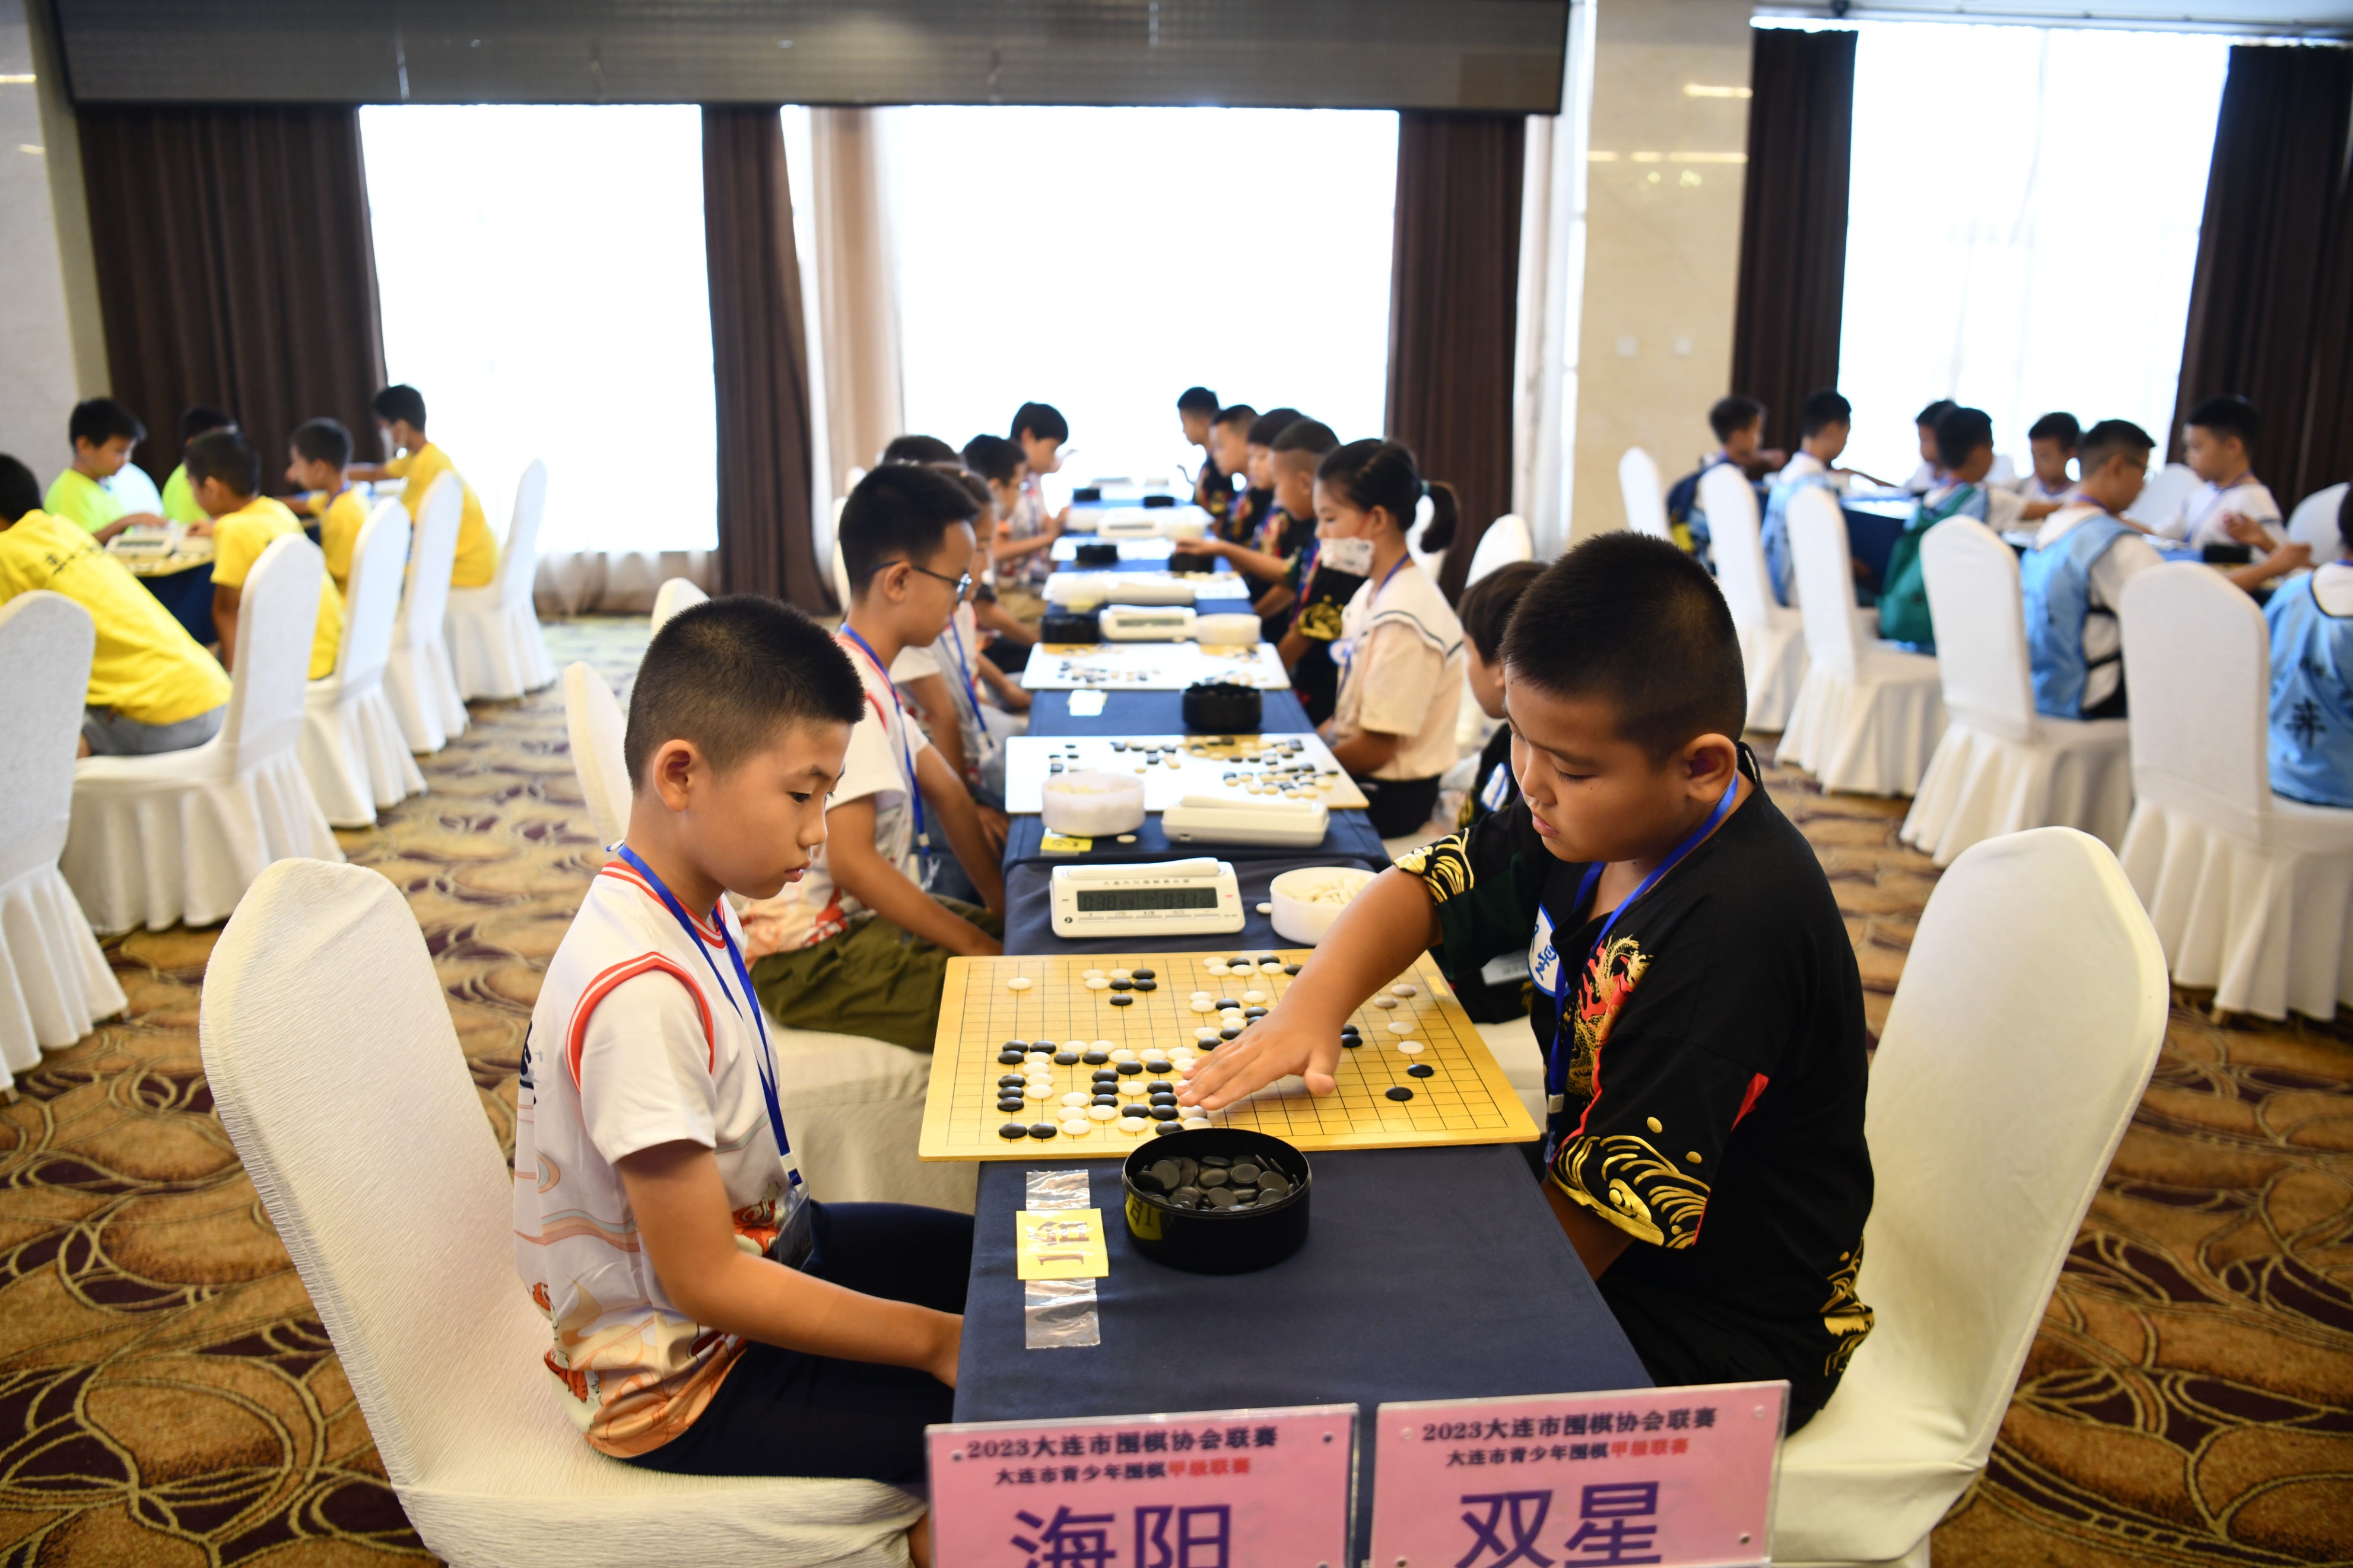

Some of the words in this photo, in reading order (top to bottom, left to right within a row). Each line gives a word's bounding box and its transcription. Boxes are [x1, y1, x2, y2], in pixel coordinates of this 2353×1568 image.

[967, 1425, 1278, 1458] 2023大连市围棋协会联赛
[1422, 1408, 1717, 1441] 2023大连市围棋协会联赛
[1010, 1504, 1231, 1568] 海阳
[1455, 1481, 1662, 1568] 双星
